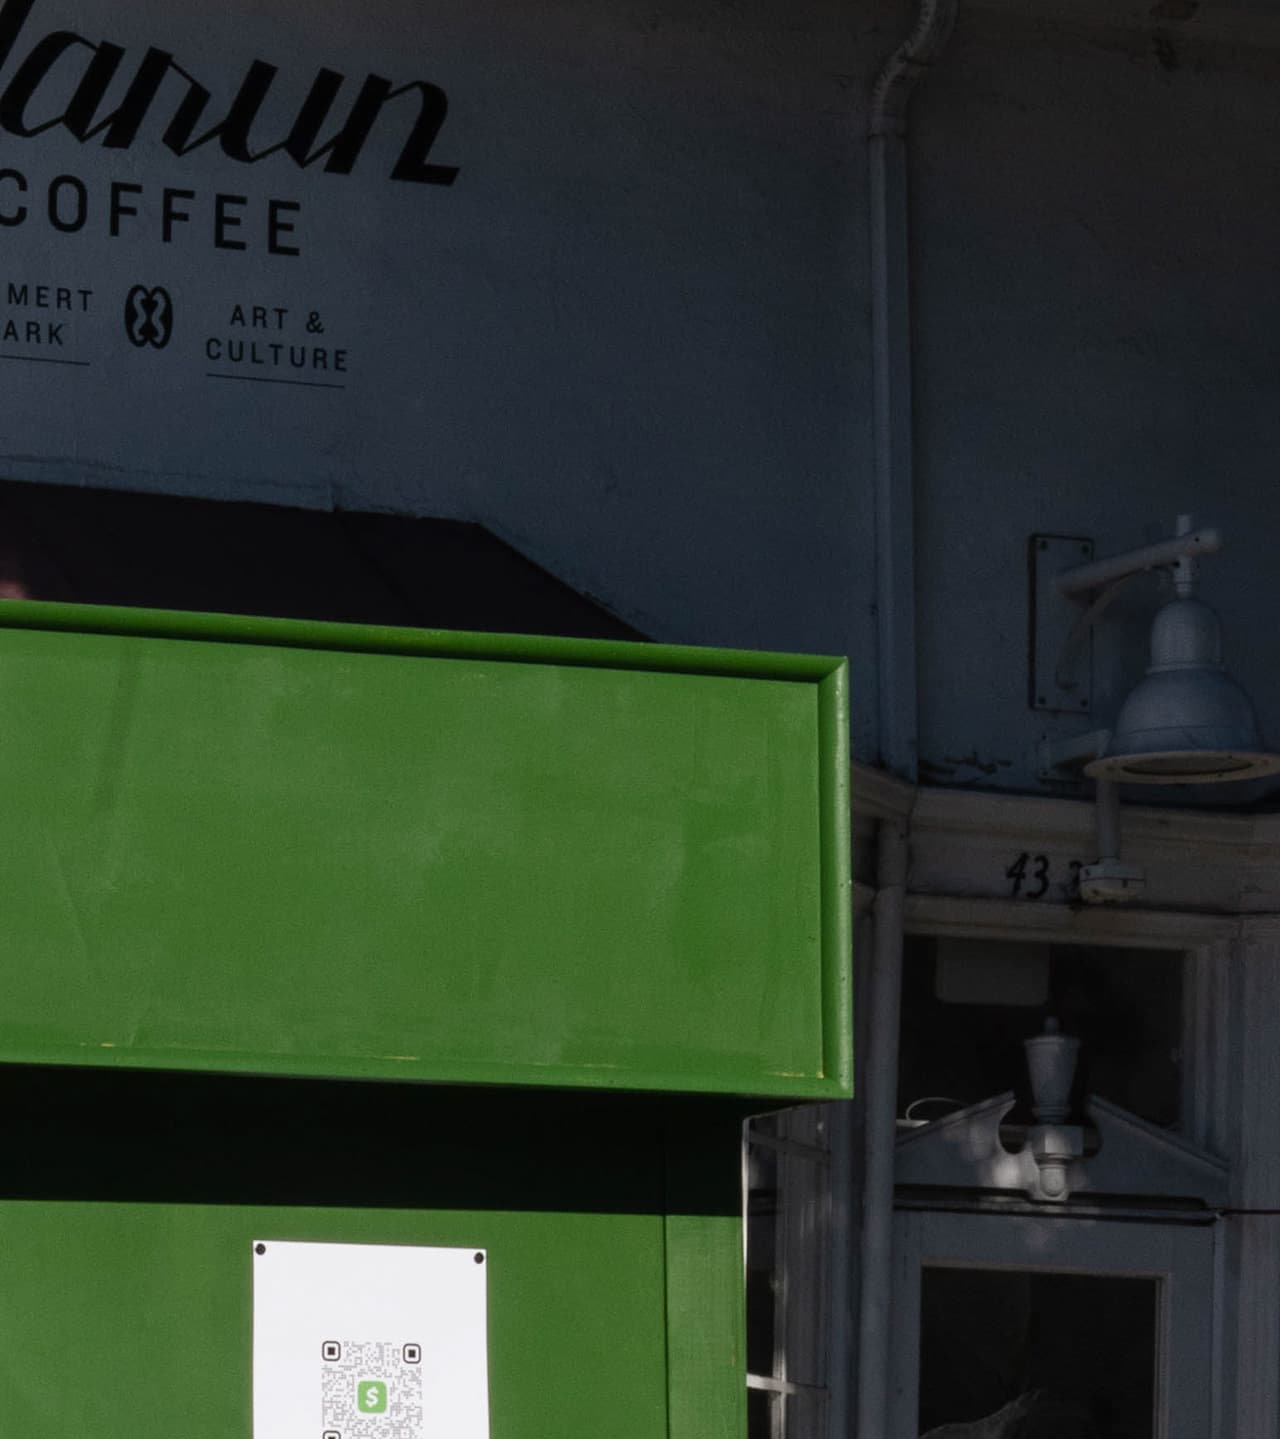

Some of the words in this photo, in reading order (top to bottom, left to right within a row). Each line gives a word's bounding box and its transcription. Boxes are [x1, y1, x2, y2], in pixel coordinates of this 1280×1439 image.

[230, 304, 288, 331] ART
[305, 312, 325, 335] &
[205, 338, 348, 372] CULTURE
